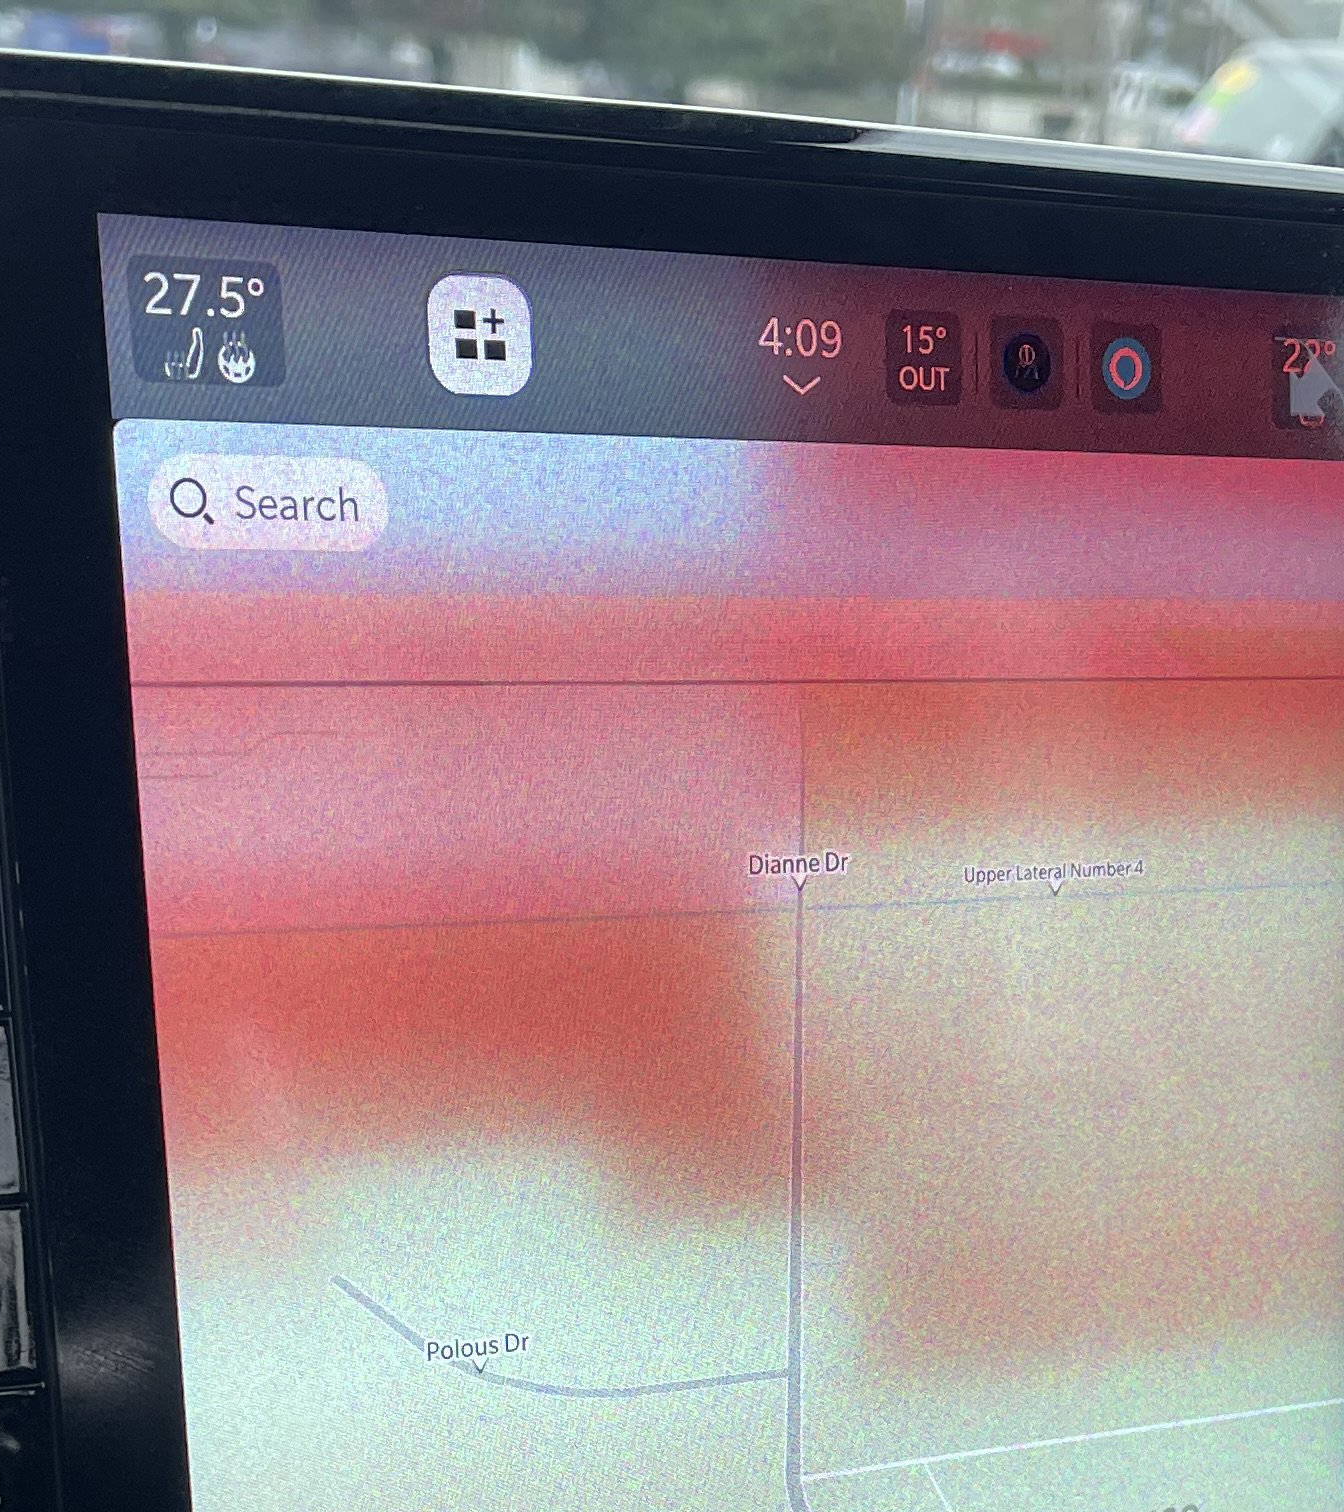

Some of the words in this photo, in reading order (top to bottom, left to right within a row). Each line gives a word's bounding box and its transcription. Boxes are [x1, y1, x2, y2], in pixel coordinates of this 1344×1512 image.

[143, 271, 265, 319] 27.5°
[758, 316, 843, 359] 4:09
[902, 324, 947, 355] 15°
[898, 365, 951, 392] OUT
[235, 484, 359, 522] Search
[748, 854, 820, 875] Dianne
[824, 852, 849, 873] Dr
[963, 865, 1014, 885] Upper
[1016, 863, 1067, 881] Lateral
[1069, 861, 1132, 880] Number
[1131, 859, 1144, 875] 4
[427, 1338, 499, 1361] Polous
[505, 1333, 530, 1353] Dr
